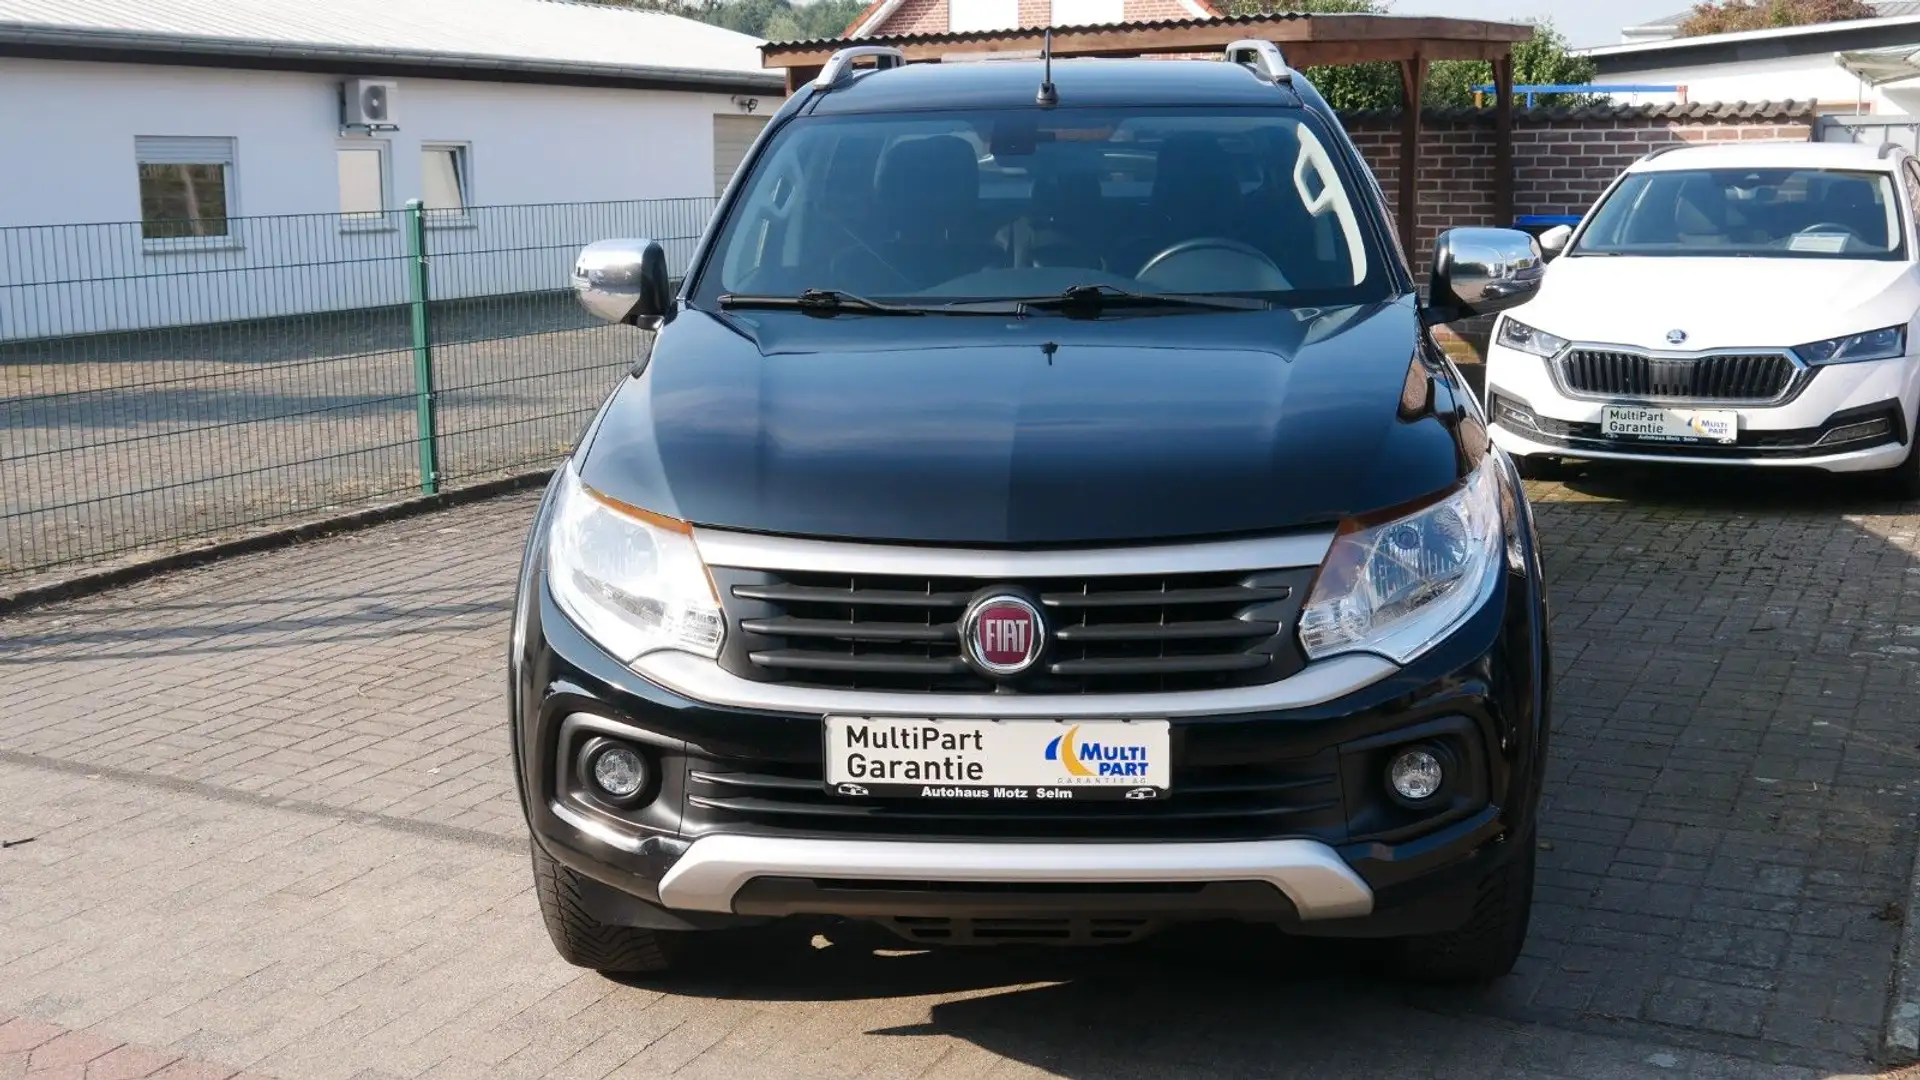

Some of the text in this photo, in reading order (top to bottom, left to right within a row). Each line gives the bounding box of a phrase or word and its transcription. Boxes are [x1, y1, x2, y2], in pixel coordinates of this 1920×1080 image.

[1610, 410, 1664, 422] MultiPart
[1610, 421, 1664, 434] Garantie
[985, 619, 1029, 653] FIAT
[846, 725, 983, 750] MultiPart
[1079, 742, 1146, 761] MULTI
[847, 753, 984, 781] Garantie
[1099, 762, 1149, 776] PART
[921, 786, 1073, 799] Autohaus Motz Selm
